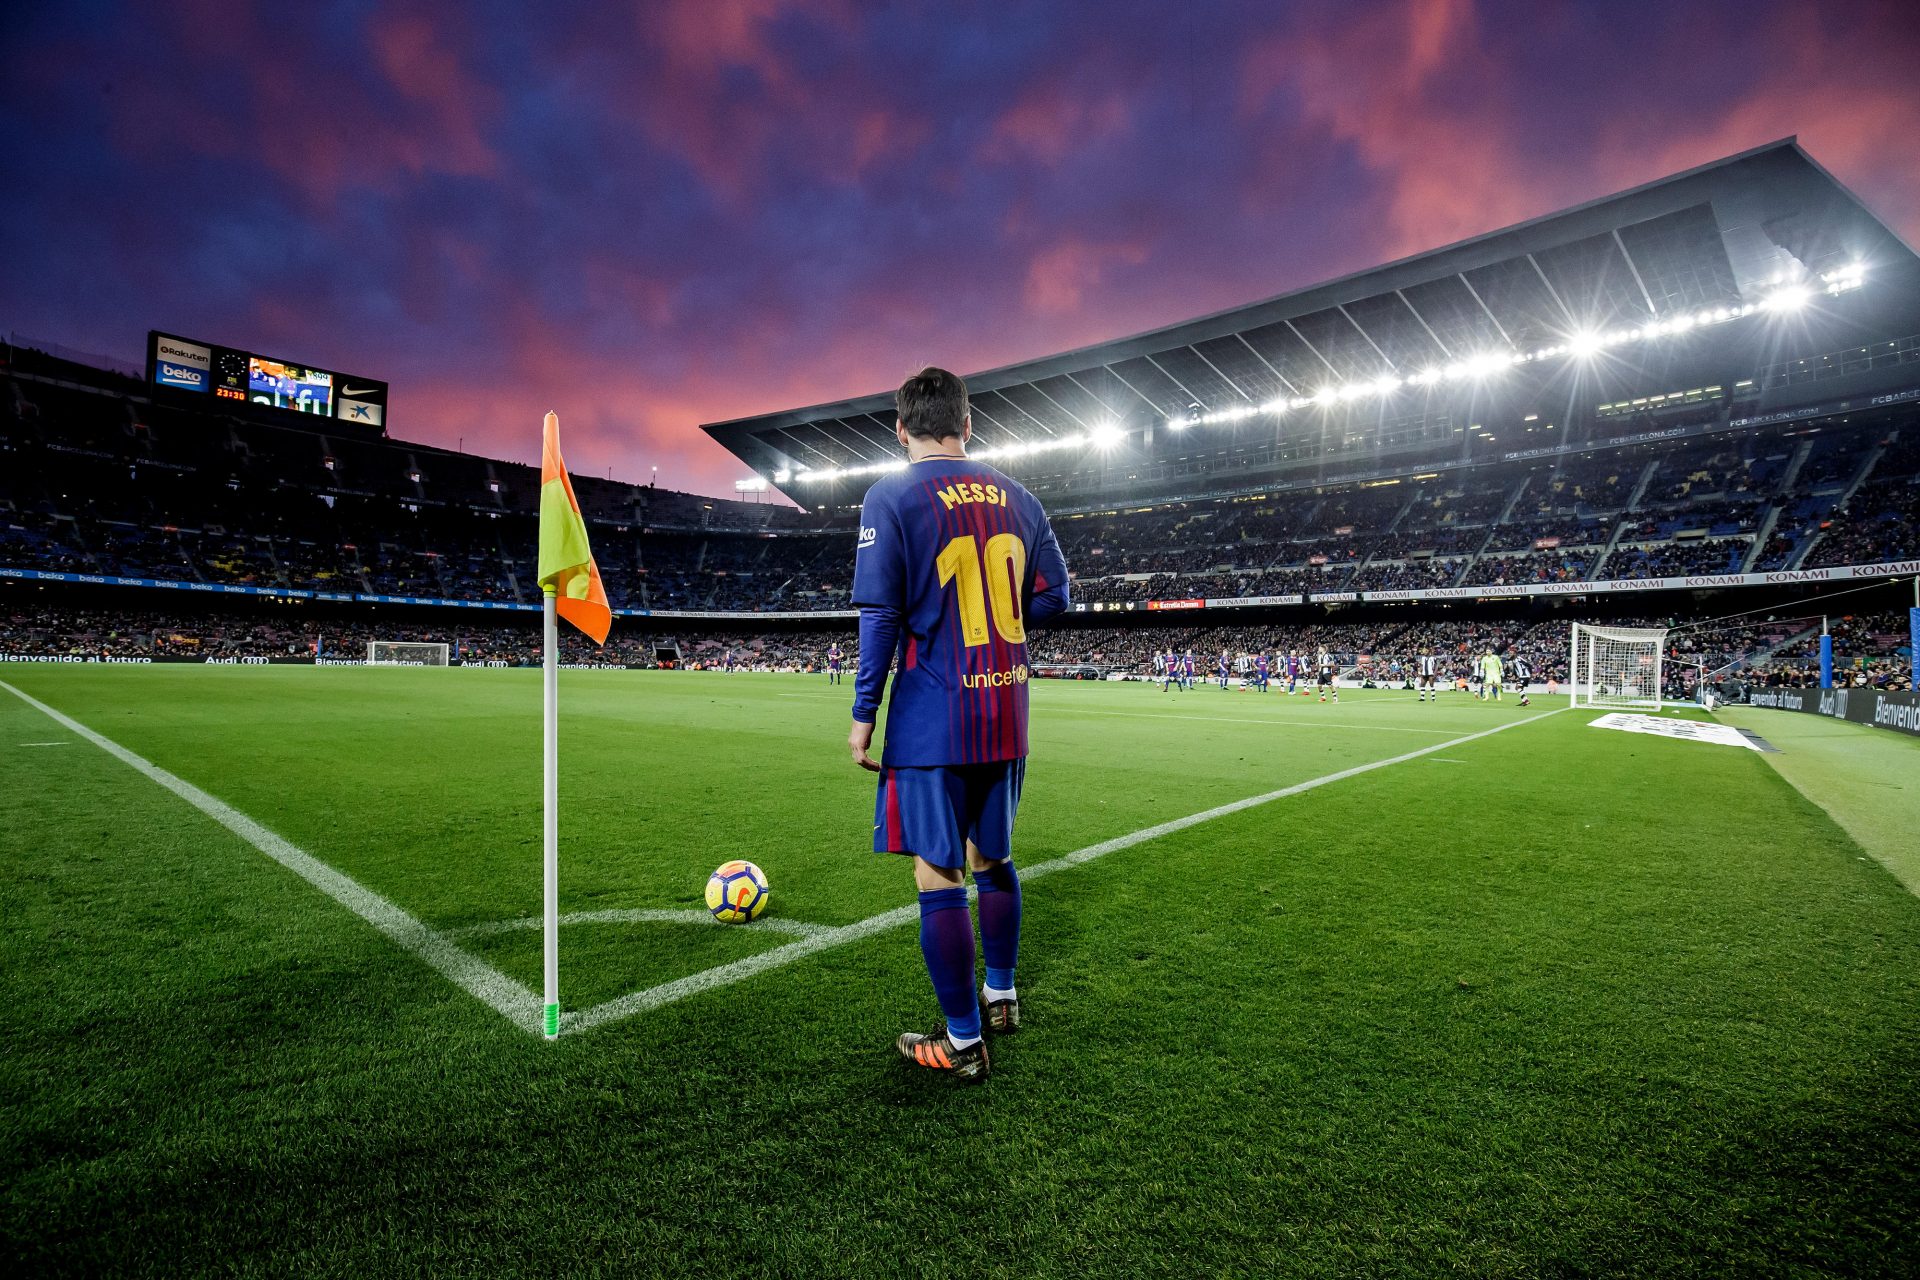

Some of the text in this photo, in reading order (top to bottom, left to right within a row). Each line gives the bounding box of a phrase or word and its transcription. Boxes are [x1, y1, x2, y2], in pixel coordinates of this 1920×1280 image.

[169, 348, 209, 363] Rakuten
[163, 365, 202, 382] beko
[217, 388, 246, 400] 23:30
[937, 483, 1007, 510] MESSI
[858, 525, 876, 541] ko
[38, 571, 65, 580] beko
[79, 574, 105, 583] beko
[118, 578, 143, 586] beko
[155, 580, 178, 588] beko
[190, 583, 213, 591] beko
[1216, 562, 1920, 606] KONAMI KONAMI KONAMI KONAMI KONAMI KONAMI KONAMI KONAMI KONAMI KONAMI KONAMI
[936, 533, 1026, 648] 10
[1076, 603, 1086, 612] 23
[86, 655, 100, 663] al
[105, 655, 152, 664] futuro
[204, 656, 237, 664] Audi
[460, 660, 484, 668] Audi
[963, 665, 1017, 688] unicef
[1751, 690, 1777, 707] envenido
[1818, 690, 1835, 714] Audi
